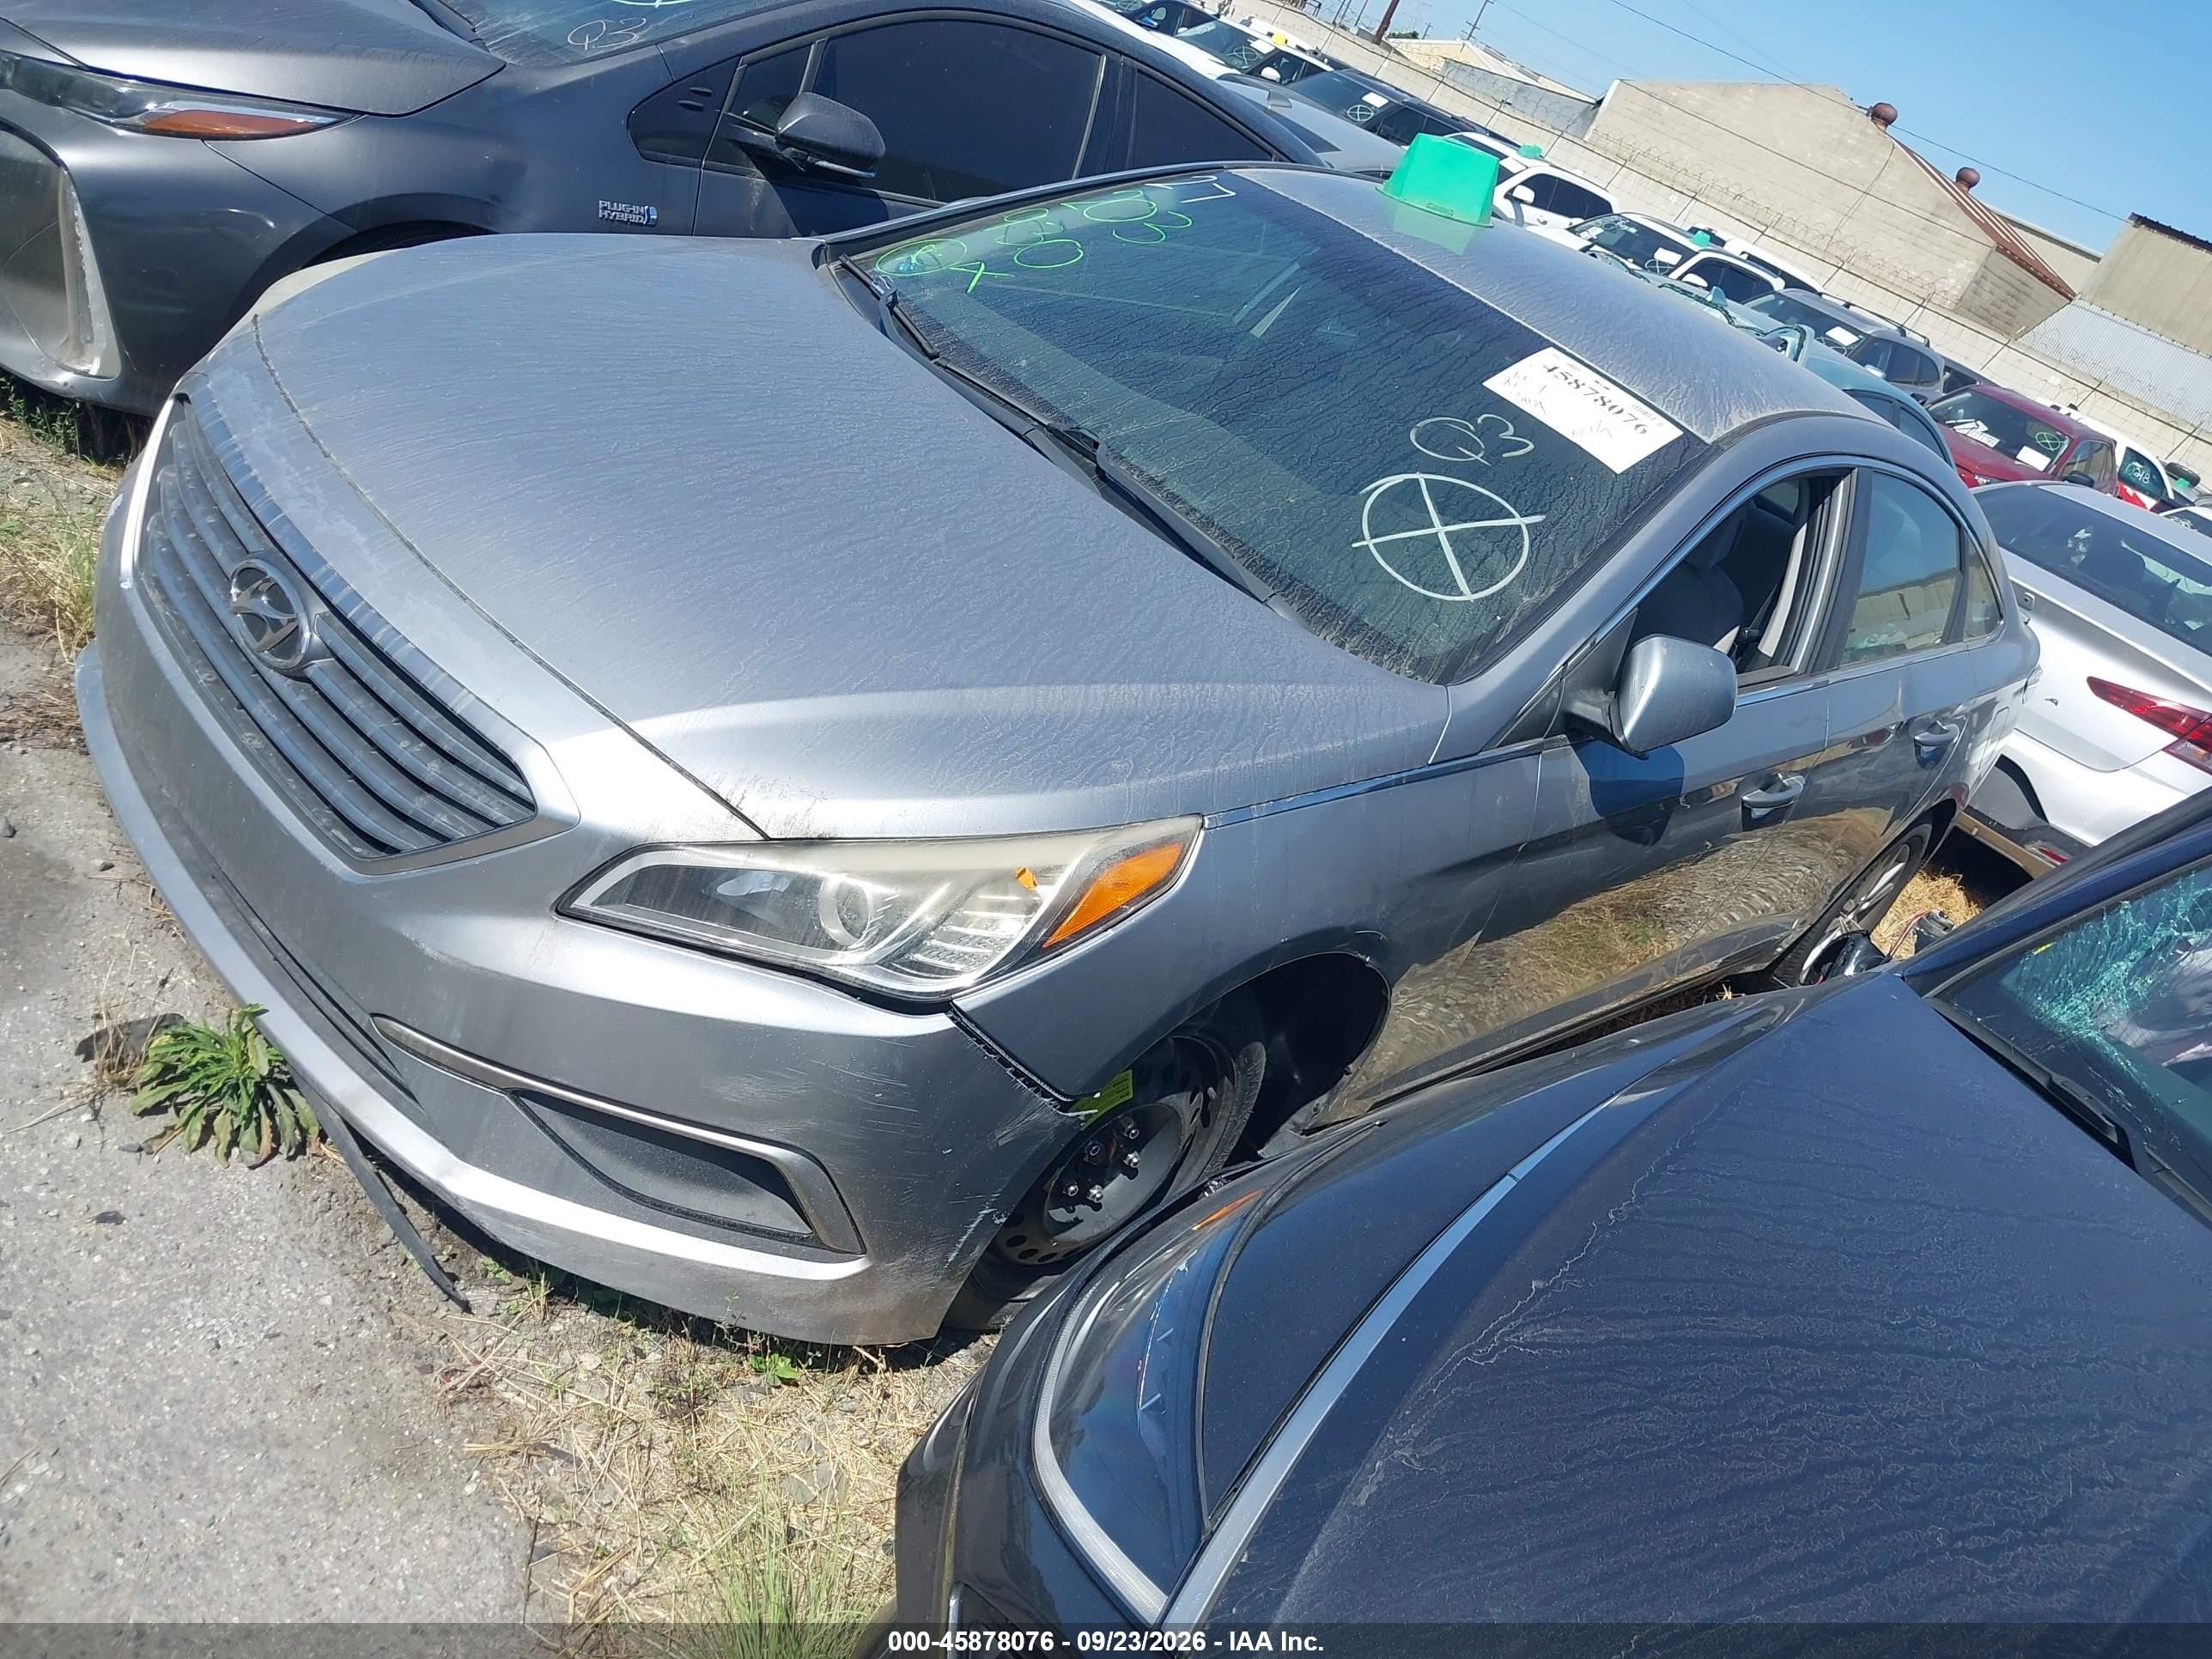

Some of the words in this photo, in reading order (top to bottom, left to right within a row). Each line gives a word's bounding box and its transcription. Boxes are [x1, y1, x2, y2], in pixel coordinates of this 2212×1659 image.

[599, 200, 644, 215] PLUG-IN
[599, 210, 644, 223] HYBRID
[1541, 364, 1648, 435] 45878076
[1409, 413, 1535, 467] Q3
